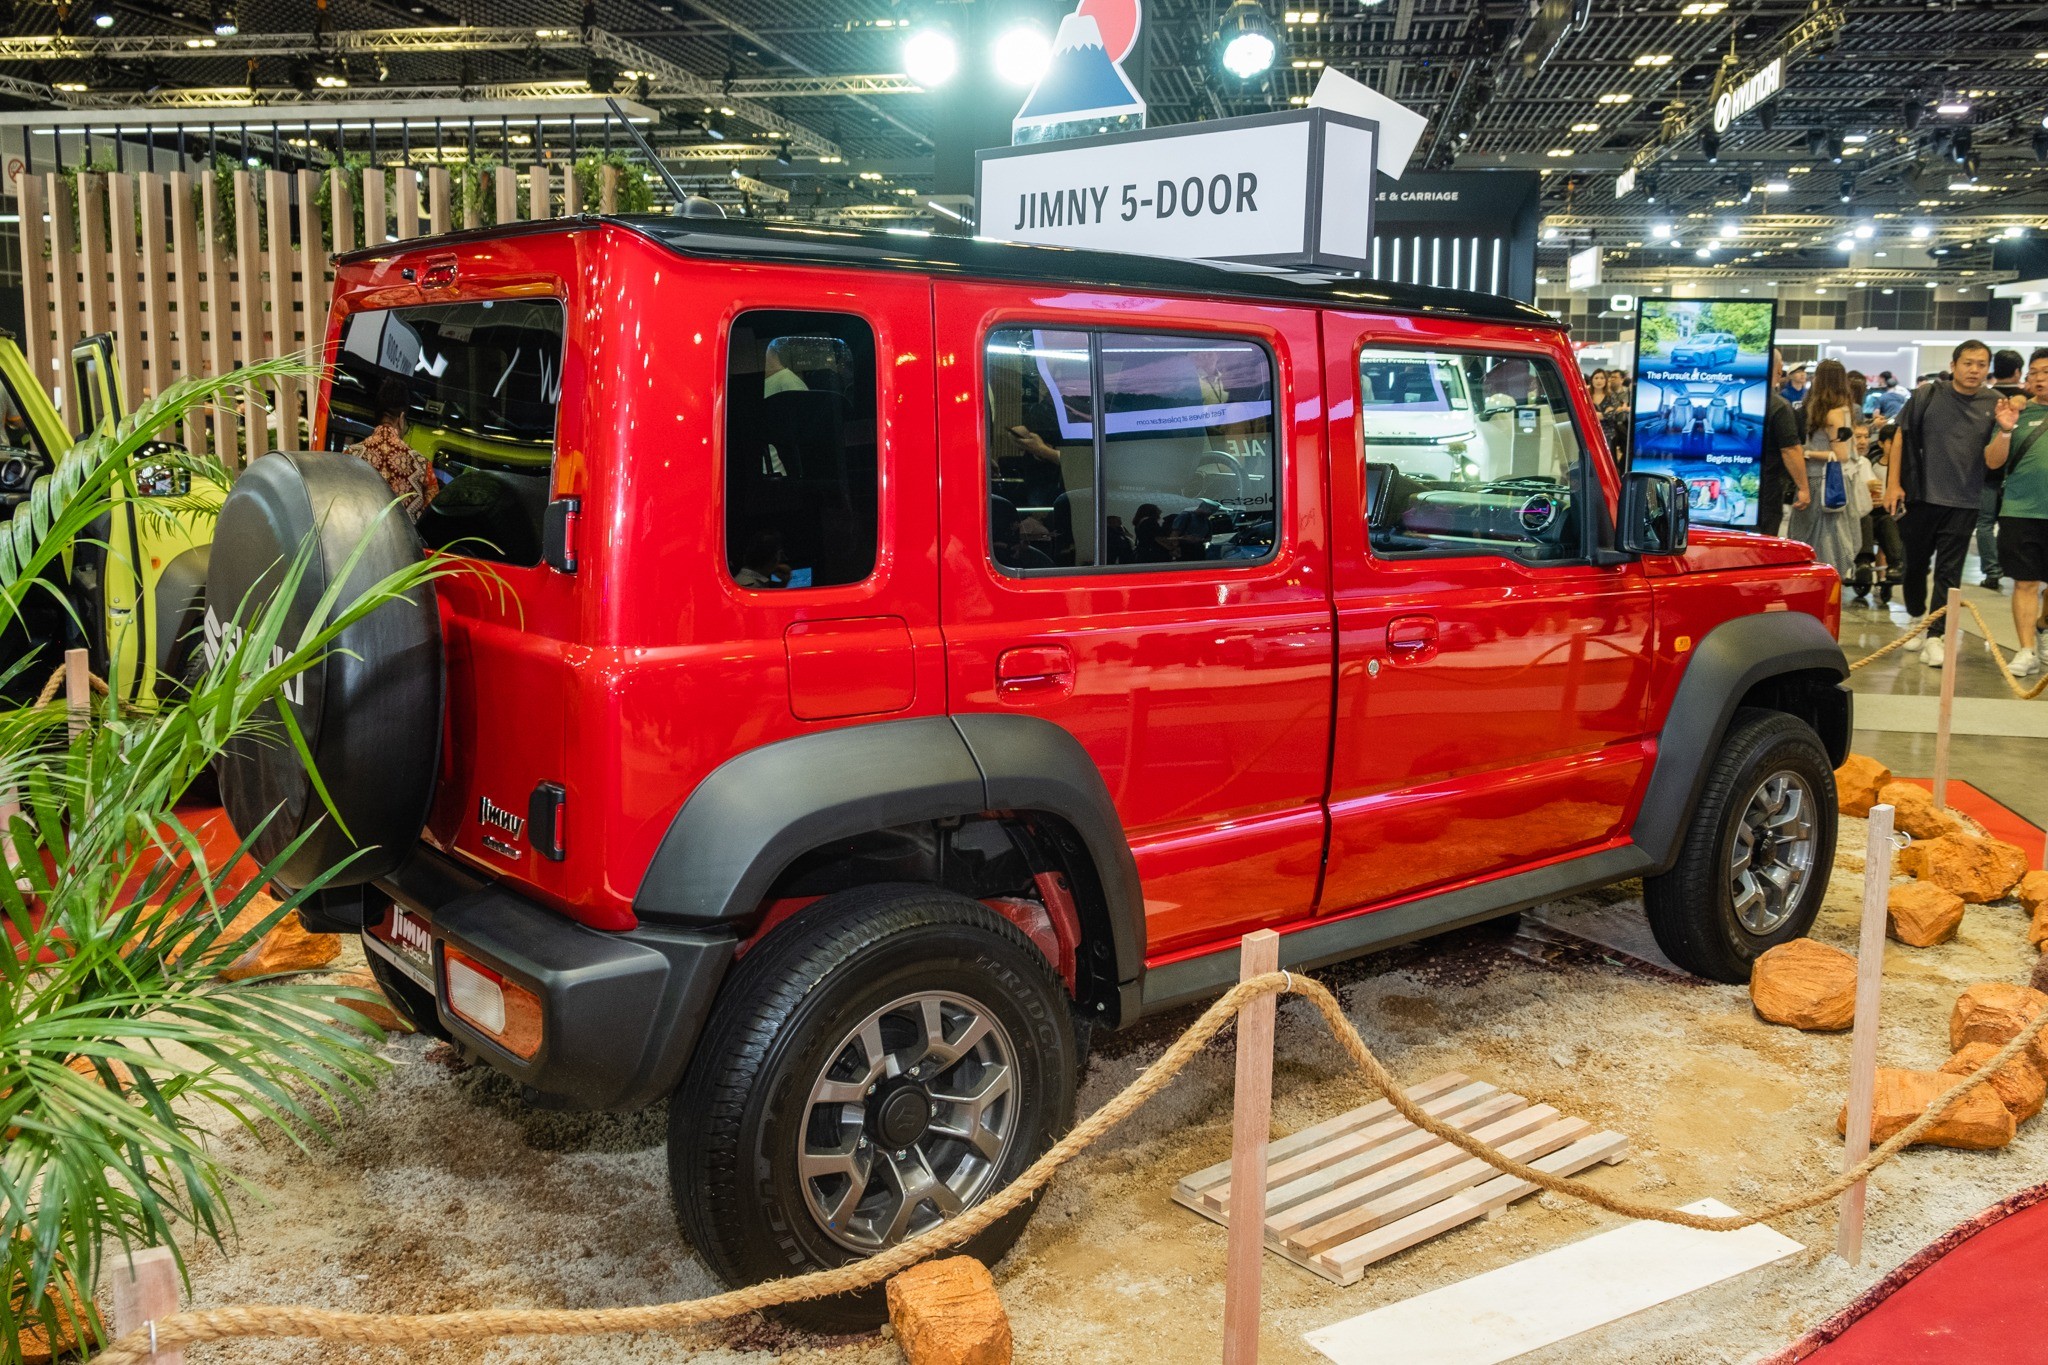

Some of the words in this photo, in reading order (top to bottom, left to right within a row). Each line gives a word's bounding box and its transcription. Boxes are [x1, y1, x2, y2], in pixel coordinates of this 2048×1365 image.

[1731, 57, 1781, 120] HYUNDAI
[1014, 185, 1109, 231] JIMNY
[1120, 172, 1259, 222] 5-DOOR
[1388, 192, 1399, 201] &
[1400, 192, 1459, 201] CARRIAGE
[1610, 295, 1638, 312] O
[1647, 371, 1662, 380] The
[1662, 371, 1690, 381] Pursuit
[1700, 372, 1733, 381] Comfort
[1706, 454, 1732, 464] Begins
[1733, 455, 1753, 464] Here
[402, 940, 427, 965] 5-door
